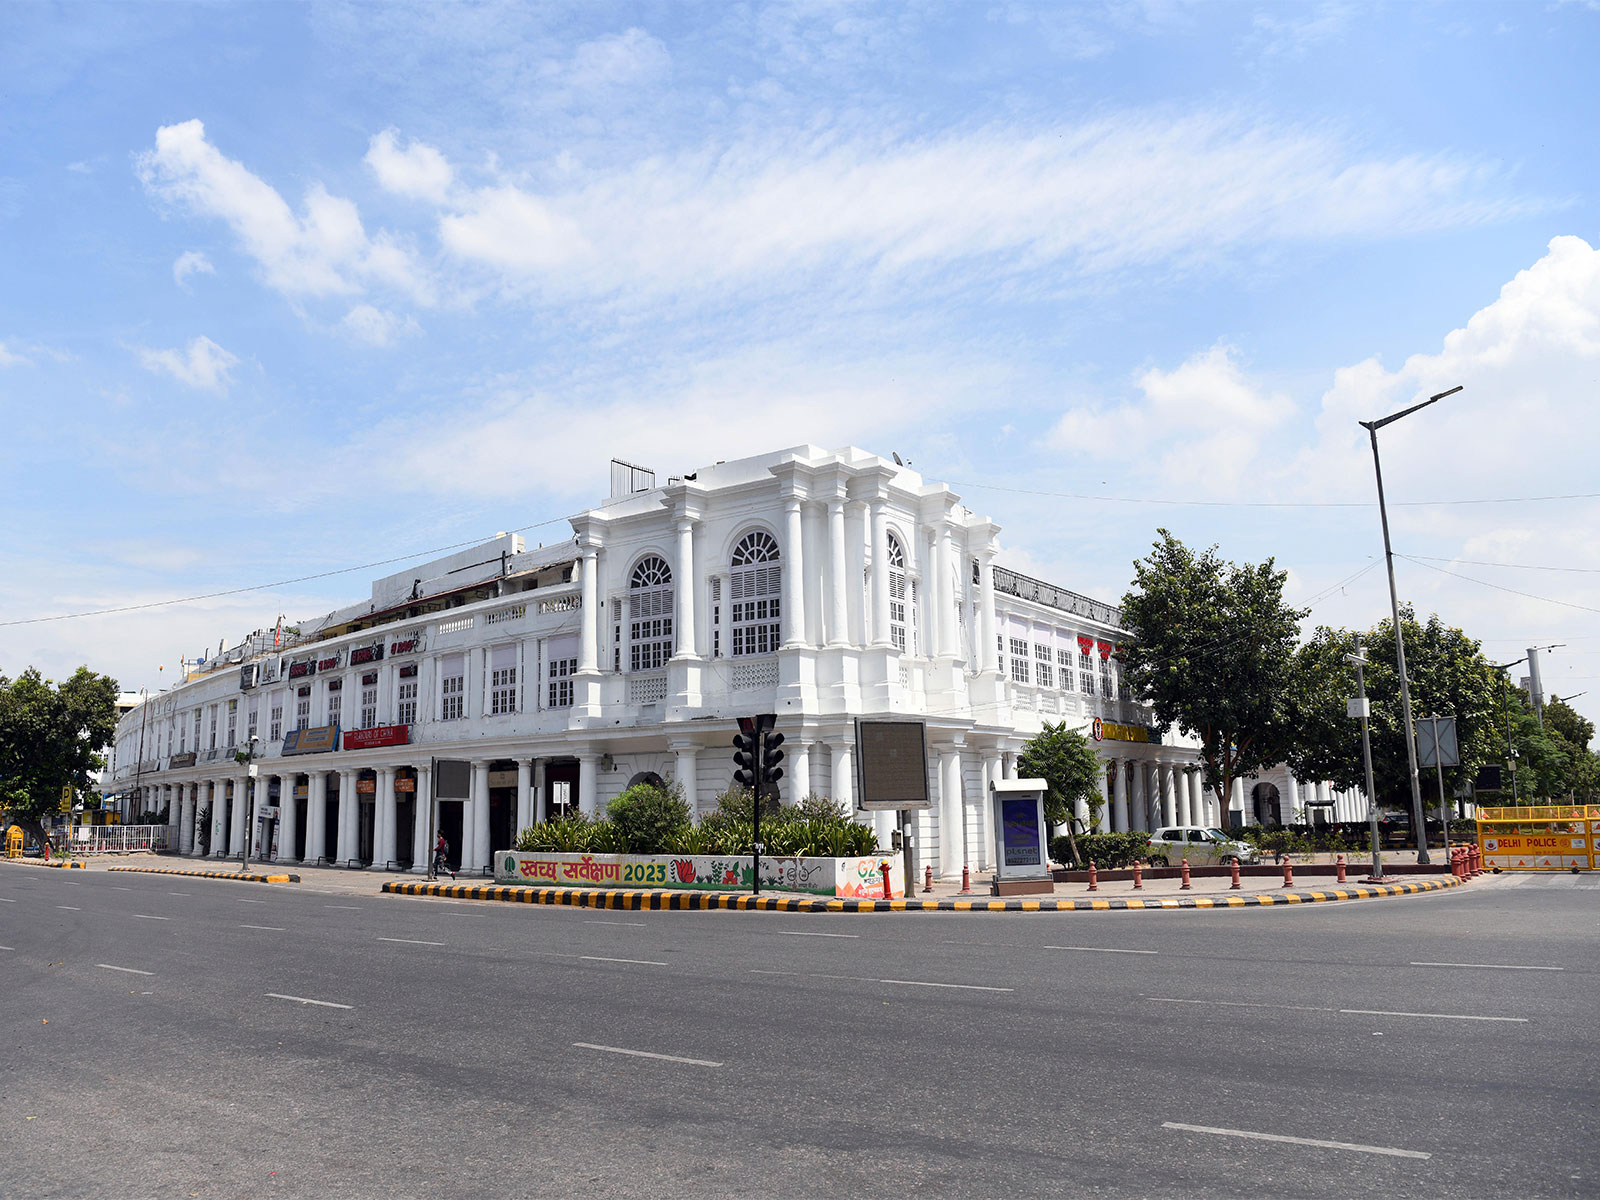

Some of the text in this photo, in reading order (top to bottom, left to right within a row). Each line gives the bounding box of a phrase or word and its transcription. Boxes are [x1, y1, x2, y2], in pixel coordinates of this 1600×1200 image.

[1498, 838, 1557, 848] DELHI POLICE
[623, 863, 667, 883] 2023
